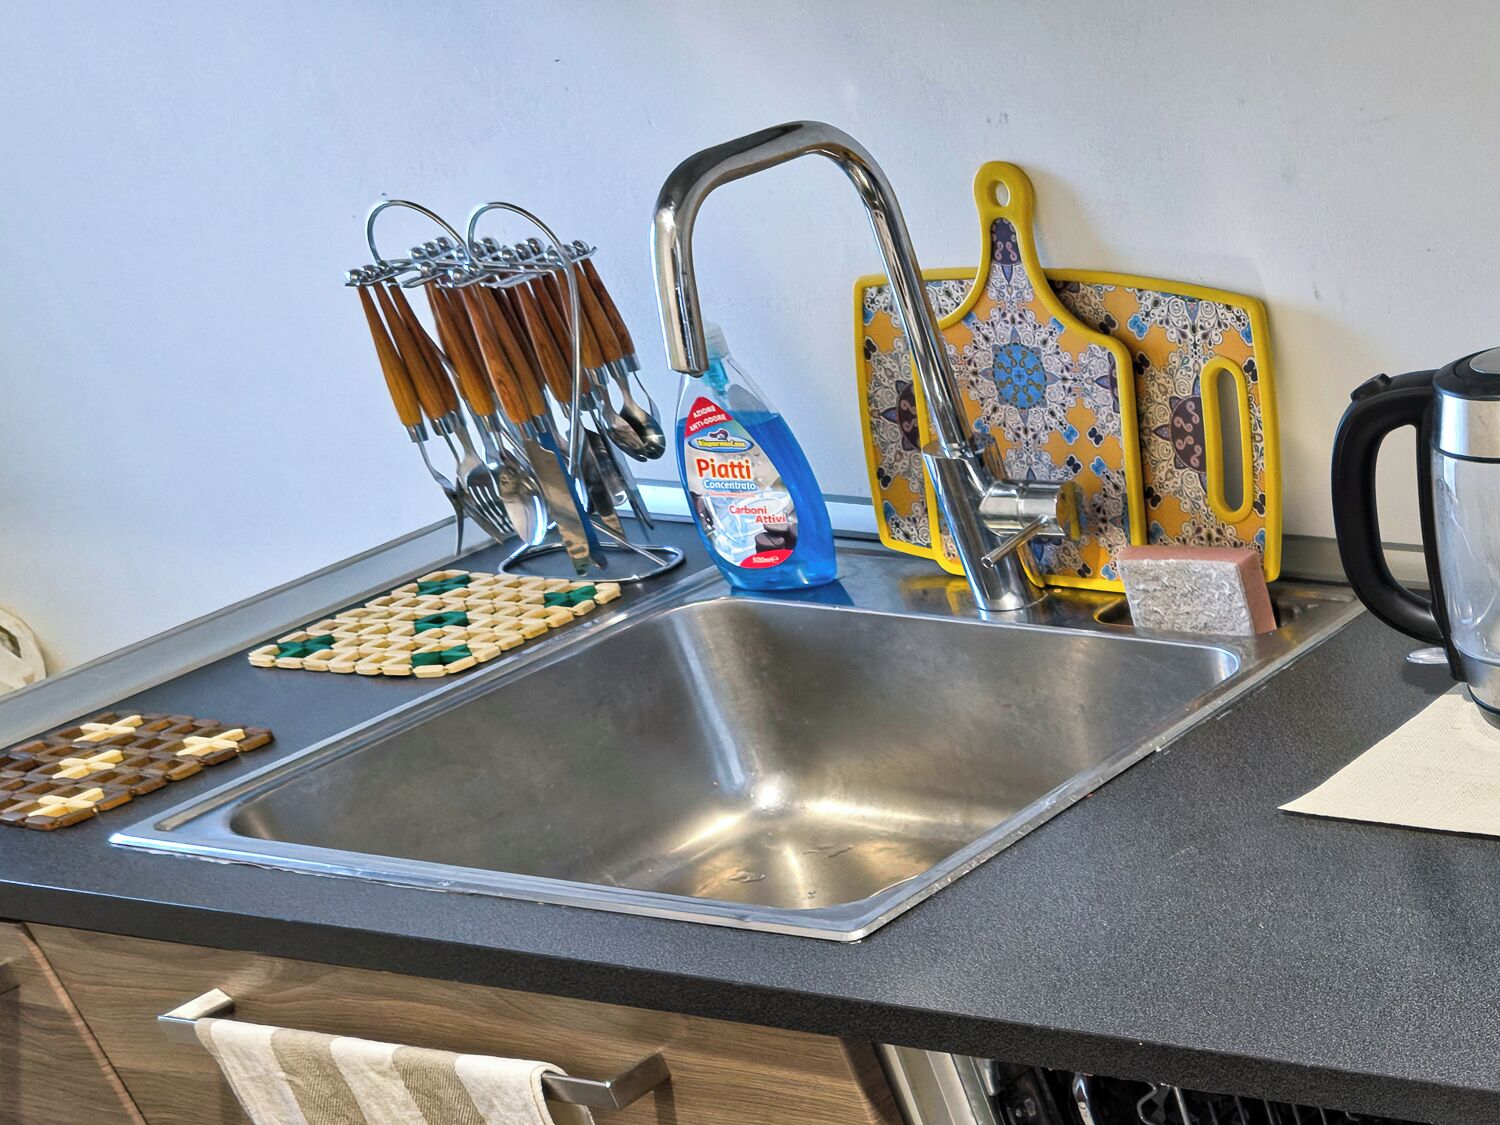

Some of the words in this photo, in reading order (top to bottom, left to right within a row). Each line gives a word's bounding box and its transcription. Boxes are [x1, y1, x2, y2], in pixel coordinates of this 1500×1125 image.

[696, 458, 751, 479] Piatti
[703, 480, 757, 490] Concentrato
[729, 505, 768, 515] Carboni
[755, 514, 788, 524] Attivi
